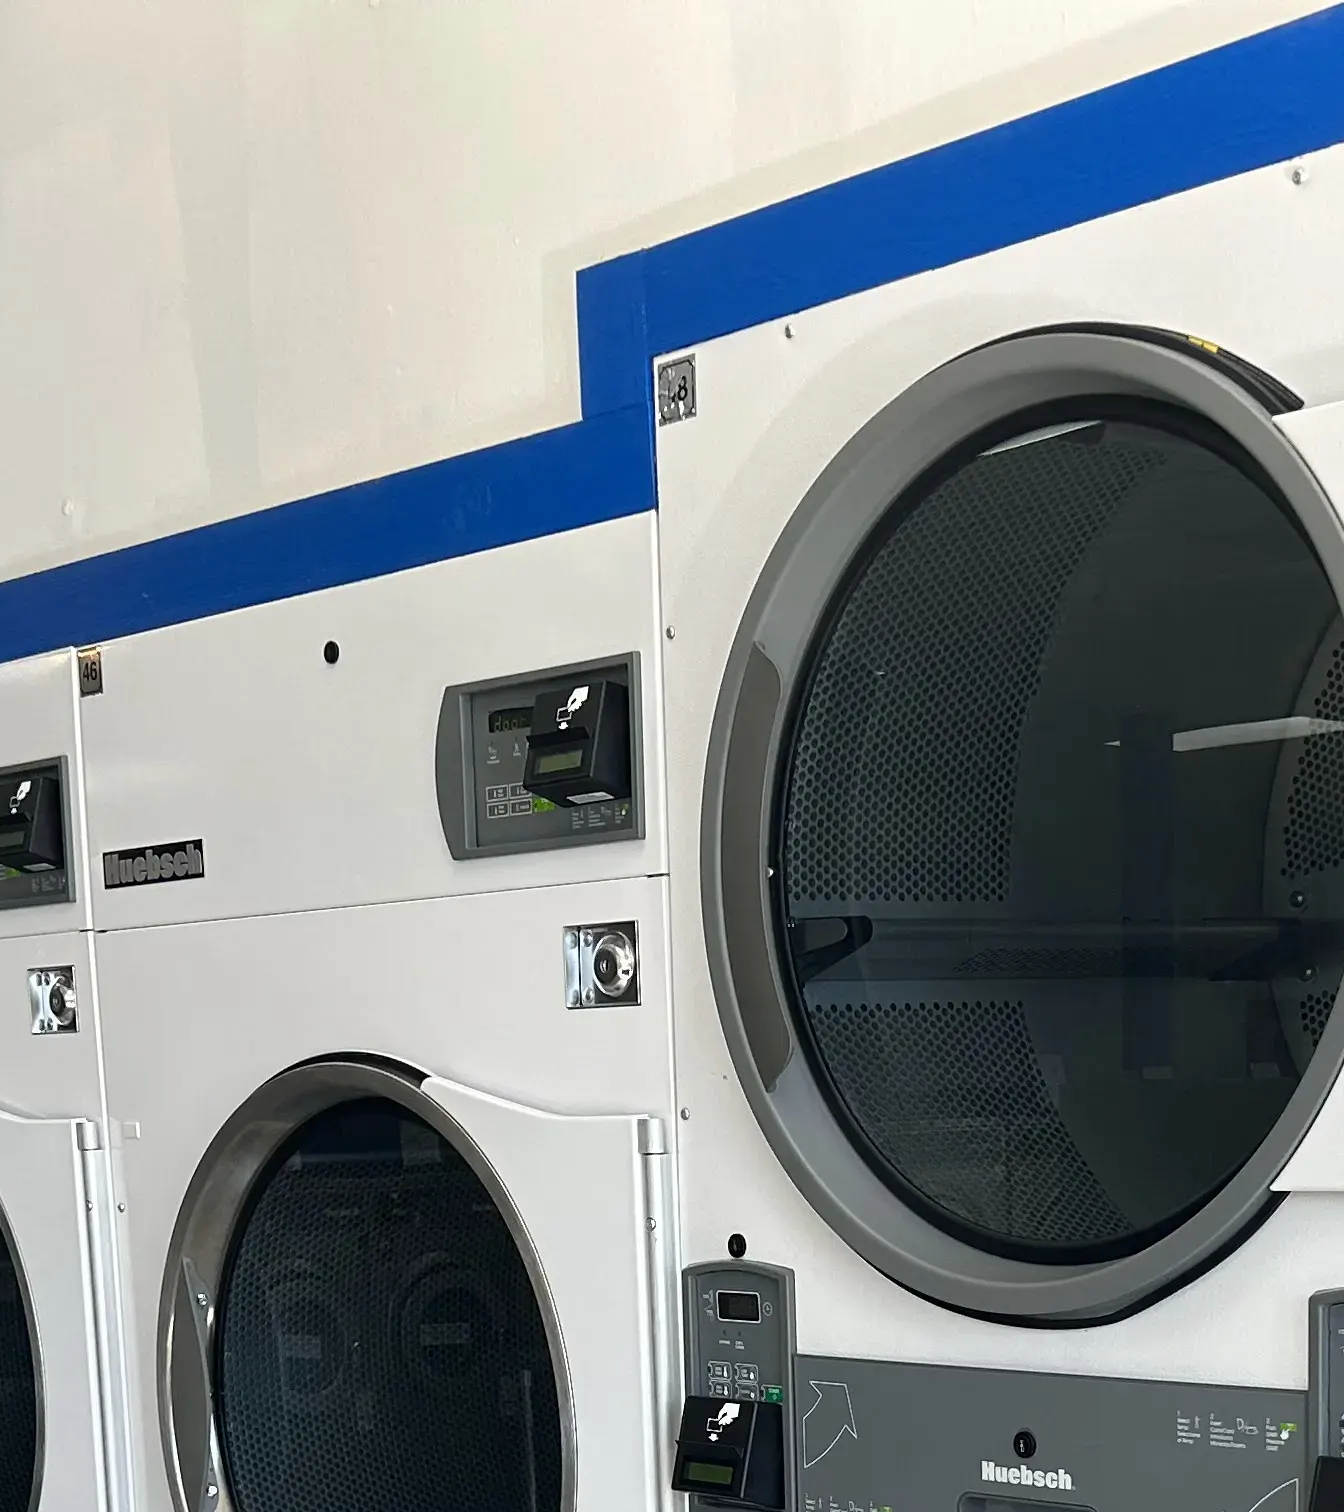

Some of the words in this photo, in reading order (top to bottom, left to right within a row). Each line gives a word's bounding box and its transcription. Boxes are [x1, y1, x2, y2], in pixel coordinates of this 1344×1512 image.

[83, 661, 97, 681] 46
[104, 844, 202, 885] Huebsch
[981, 1460, 1072, 1490] Huebsch
